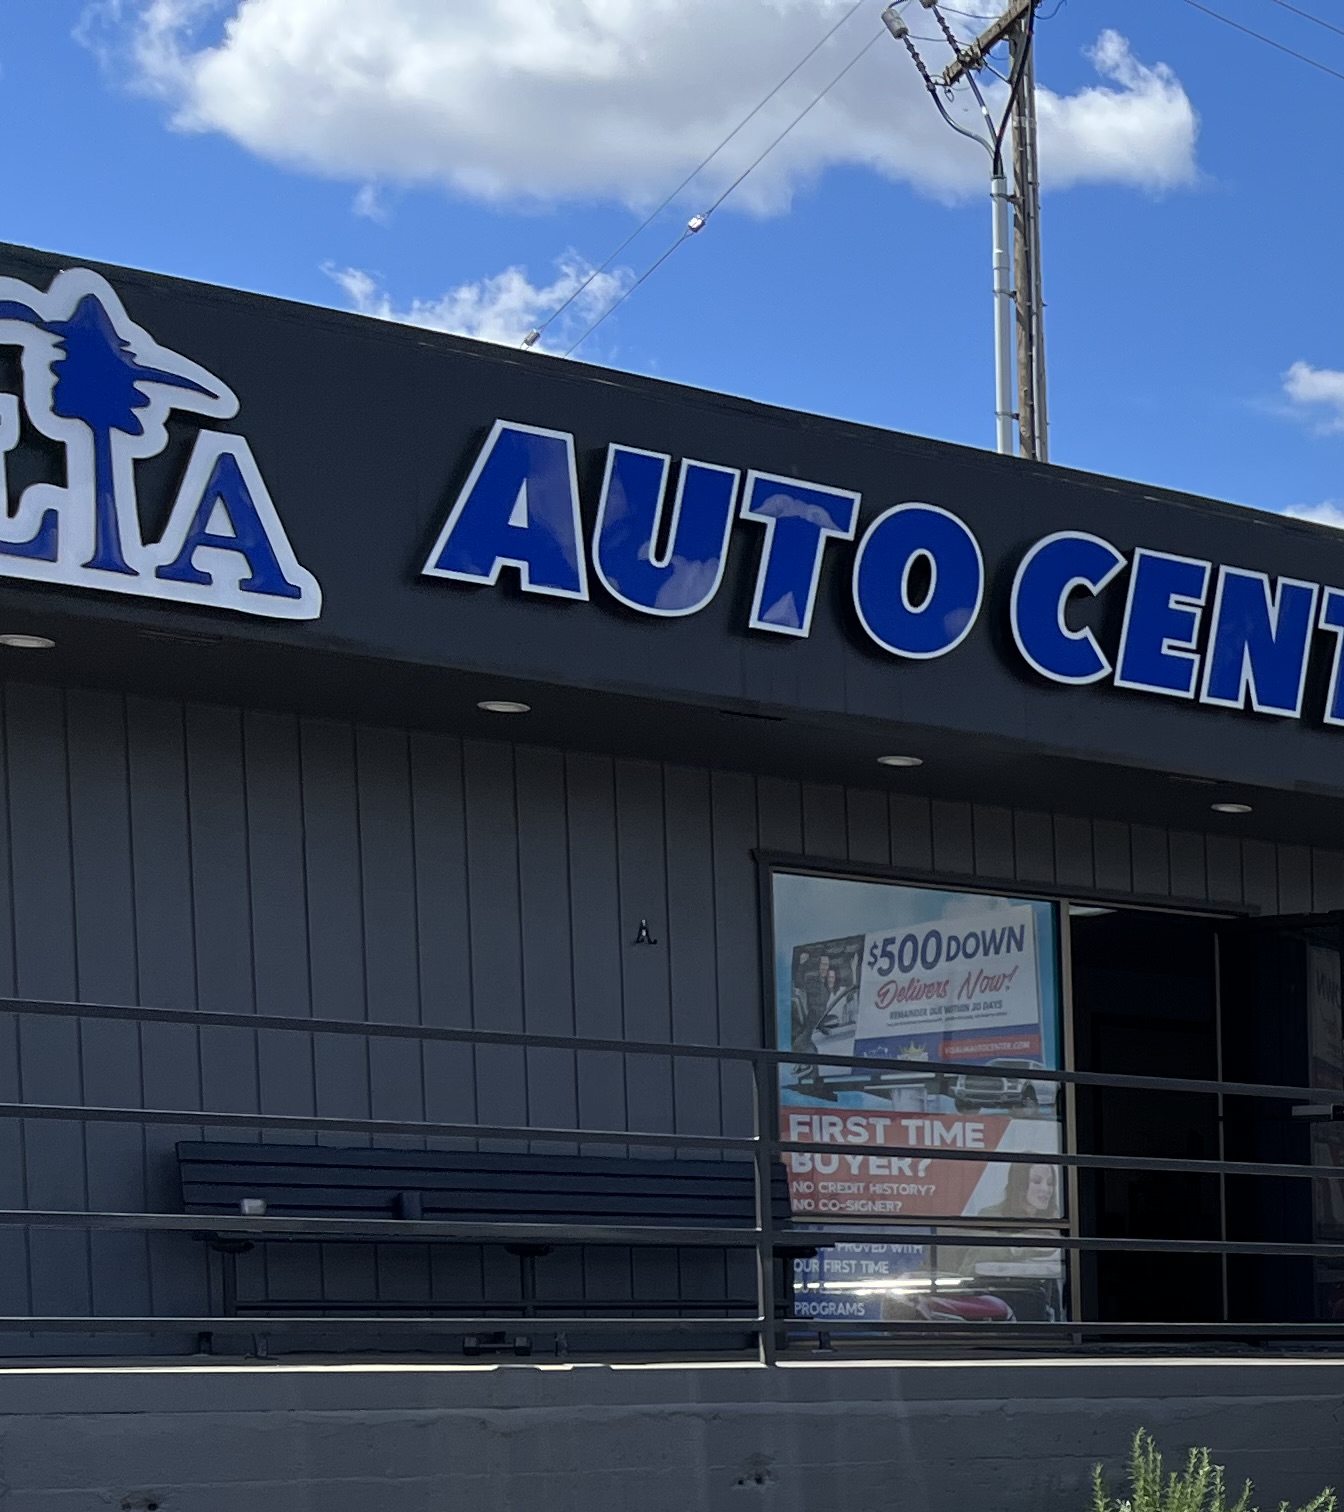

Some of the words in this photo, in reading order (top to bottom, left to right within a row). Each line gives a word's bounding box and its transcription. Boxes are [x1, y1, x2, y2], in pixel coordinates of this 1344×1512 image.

[420, 419, 984, 660] AUTO
[867, 930, 942, 977] $500
[946, 924, 1025, 962] DOWN
[875, 977, 949, 1010] Delivers
[958, 965, 1019, 1000] Now!
[789, 1114, 891, 1145] FIRST
[902, 1119, 984, 1148] TIME
[791, 1152, 932, 1177] BUYER?
[792, 1181, 815, 1194] NO
[818, 1182, 865, 1194] CREDIT
[869, 1183, 936, 1196] HISTORY?
[792, 1199, 815, 1211] NO
[818, 1200, 902, 1212] CO-SIGNER?
[794, 1259, 819, 1273] OUR
[824, 1259, 857, 1274] FIRST
[860, 1261, 889, 1274] TIME
[794, 1302, 865, 1316] PROGRAMS
